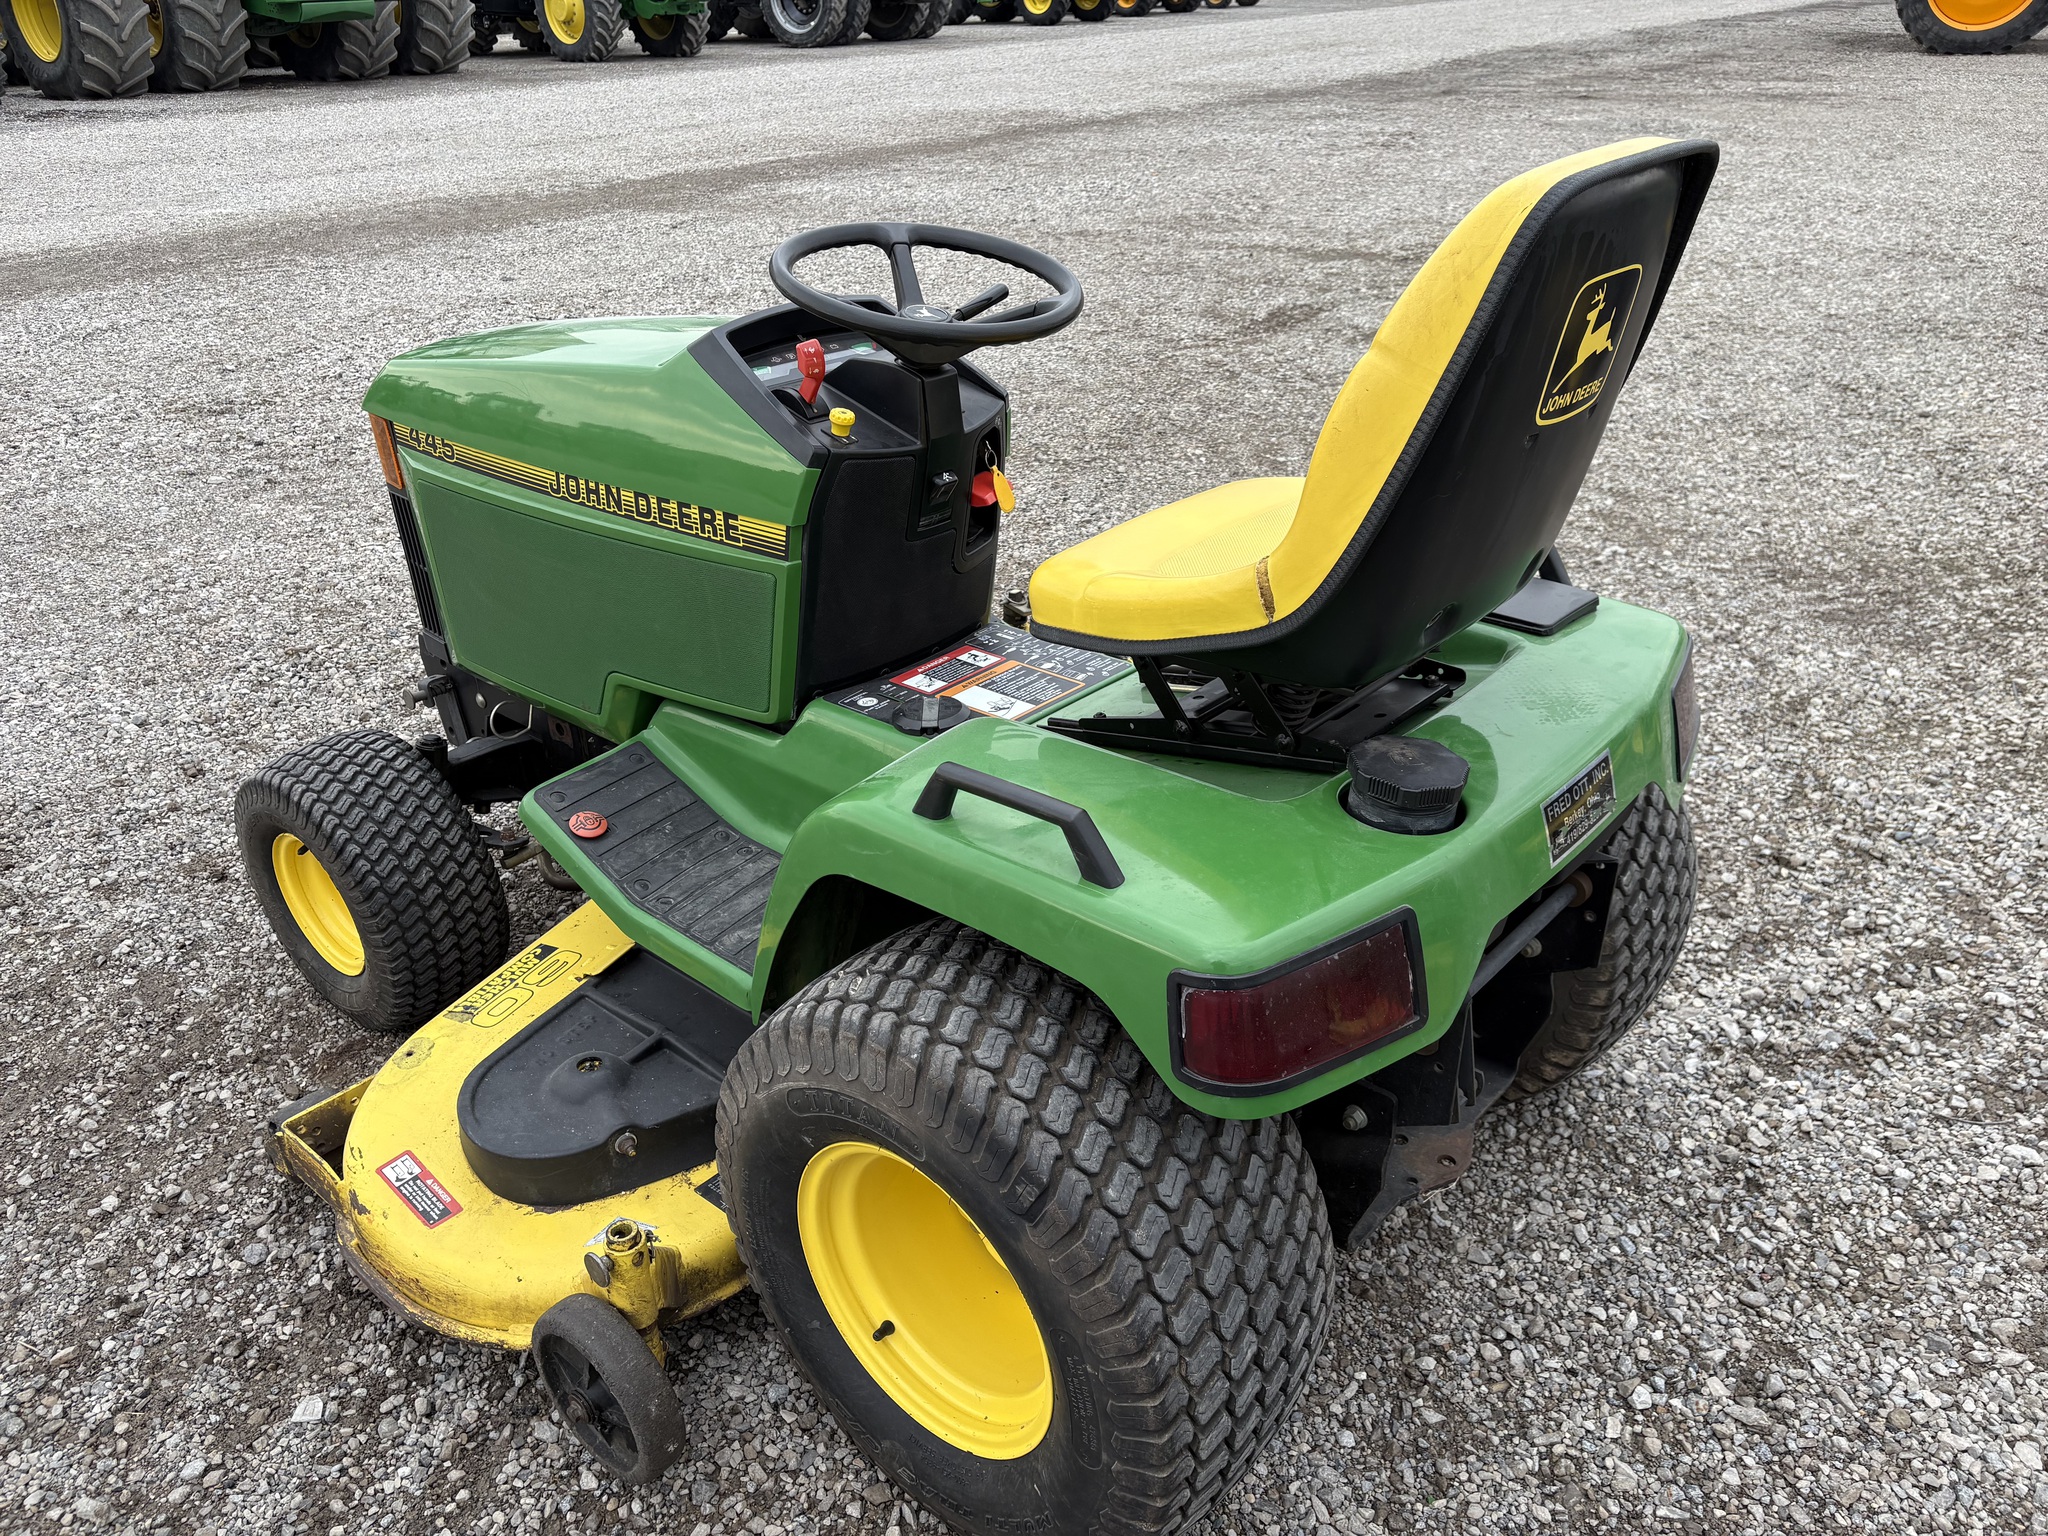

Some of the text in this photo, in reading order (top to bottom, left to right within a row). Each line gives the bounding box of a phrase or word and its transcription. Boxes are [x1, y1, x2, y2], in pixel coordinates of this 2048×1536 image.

[1542, 377, 1604, 415] JOHN DEERE
[408, 427, 457, 463] 445
[548, 471, 744, 548] JOHN DEERE
[921, 656, 950, 671] DANGER
[965, 670, 997, 687] WARNING
[1547, 762, 1610, 822] FRED OTT, INC.
[1586, 791, 1601, 809] Ohio
[471, 950, 583, 1028] 60
[472, 956, 541, 1010] MULCHER
[803, 1089, 901, 1140] TITAN
[415, 1179, 446, 1211] ROTATING BLADE
[430, 1182, 452, 1204] DANGER
[984, 1511, 1054, 1534] MULTI
